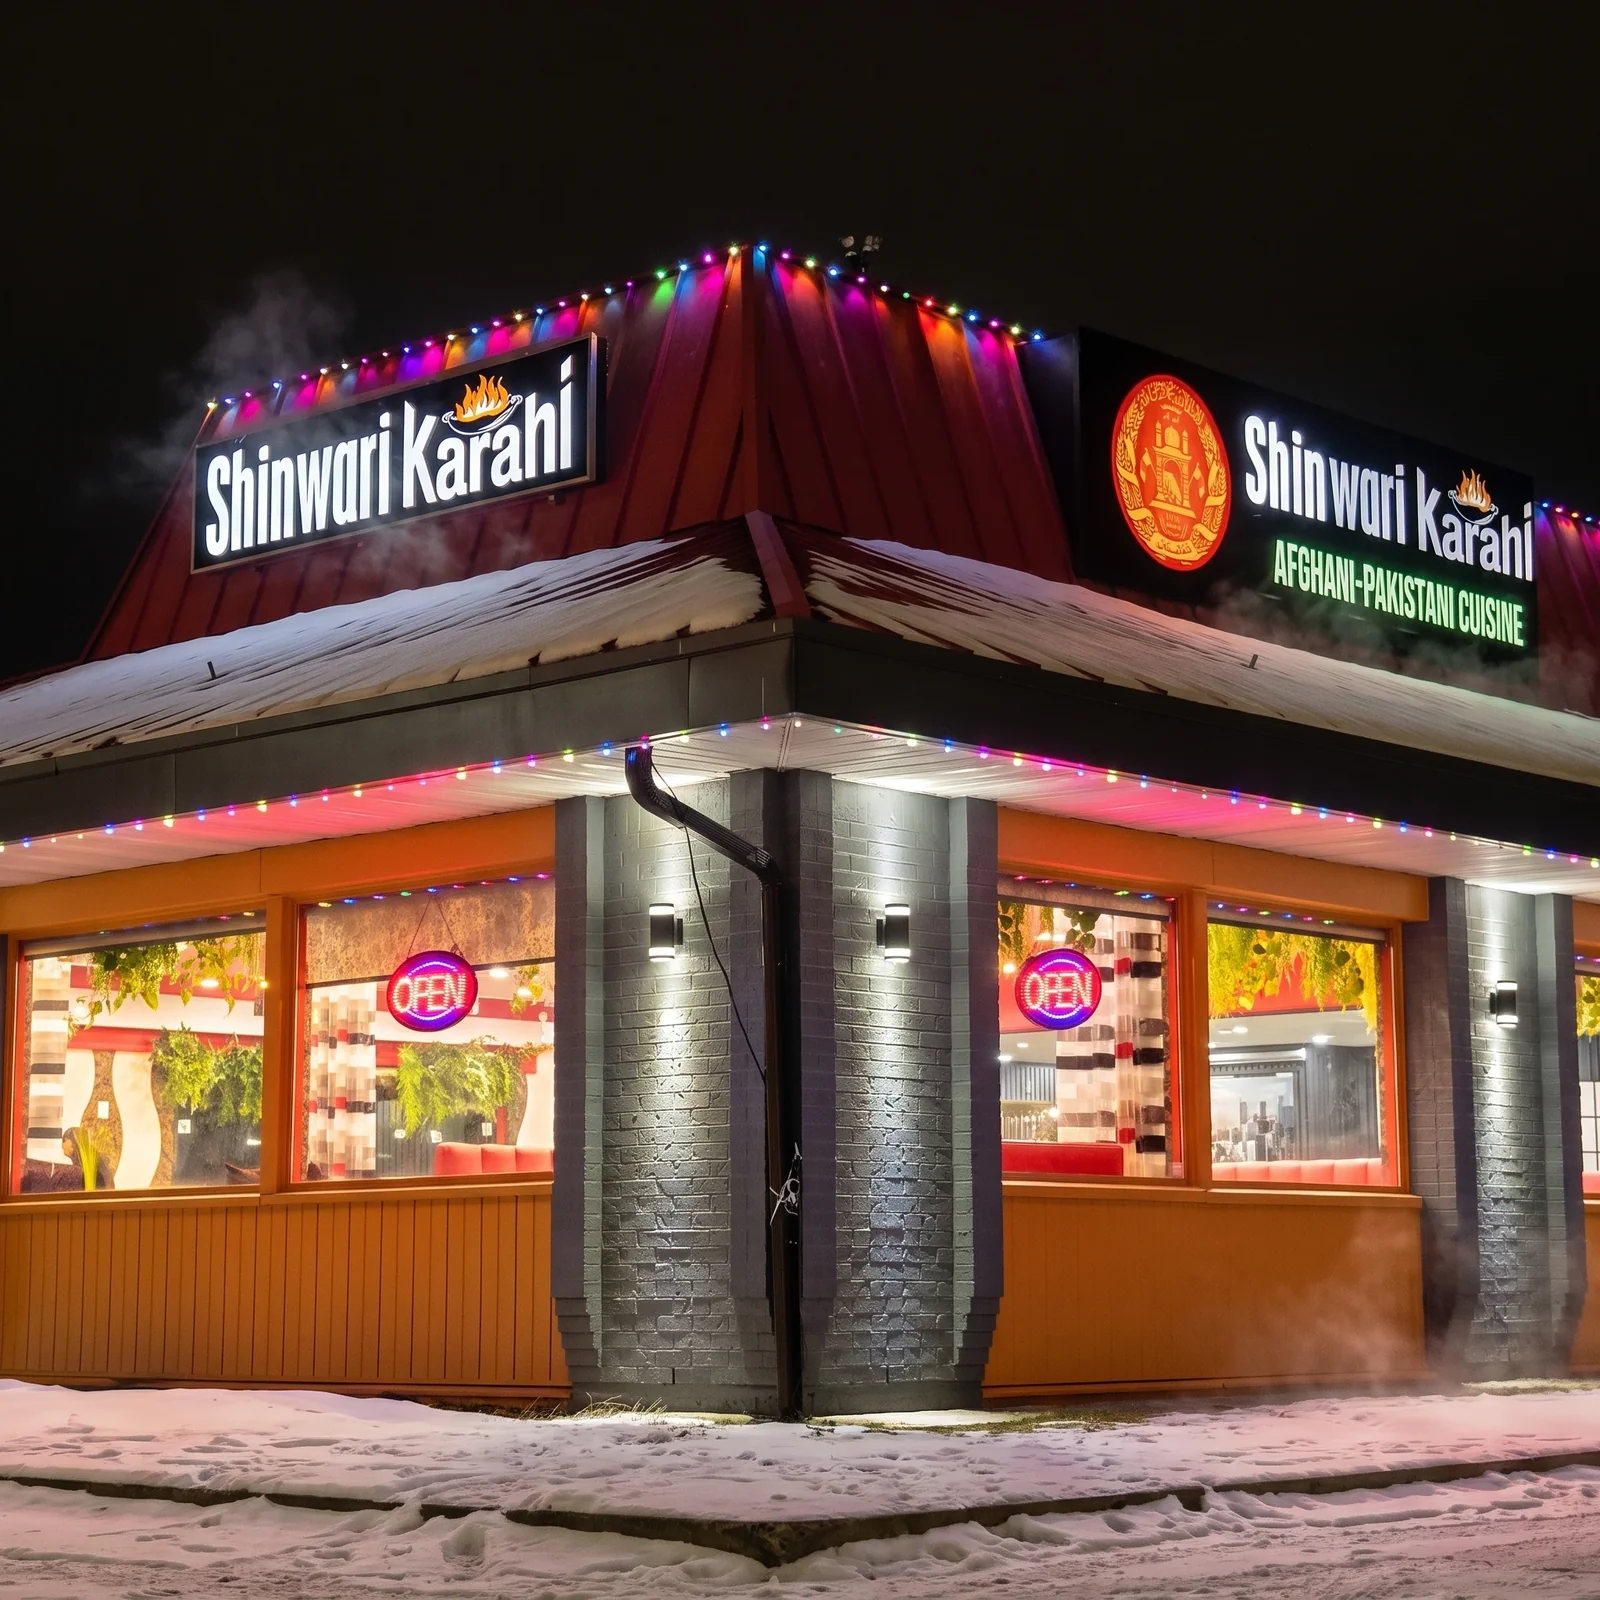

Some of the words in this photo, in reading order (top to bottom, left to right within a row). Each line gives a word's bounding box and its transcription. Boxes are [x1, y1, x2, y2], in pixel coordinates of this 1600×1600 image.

[206, 411, 391, 557] Shinwari
[1244, 414, 1406, 545] Shinwari
[1273, 539, 1454, 630] AFGHANI-PAKISTANI
[1457, 589, 1524, 647] CUISINE
[392, 973, 466, 1013] OPEN
[1021, 972, 1093, 1010] OPEN
